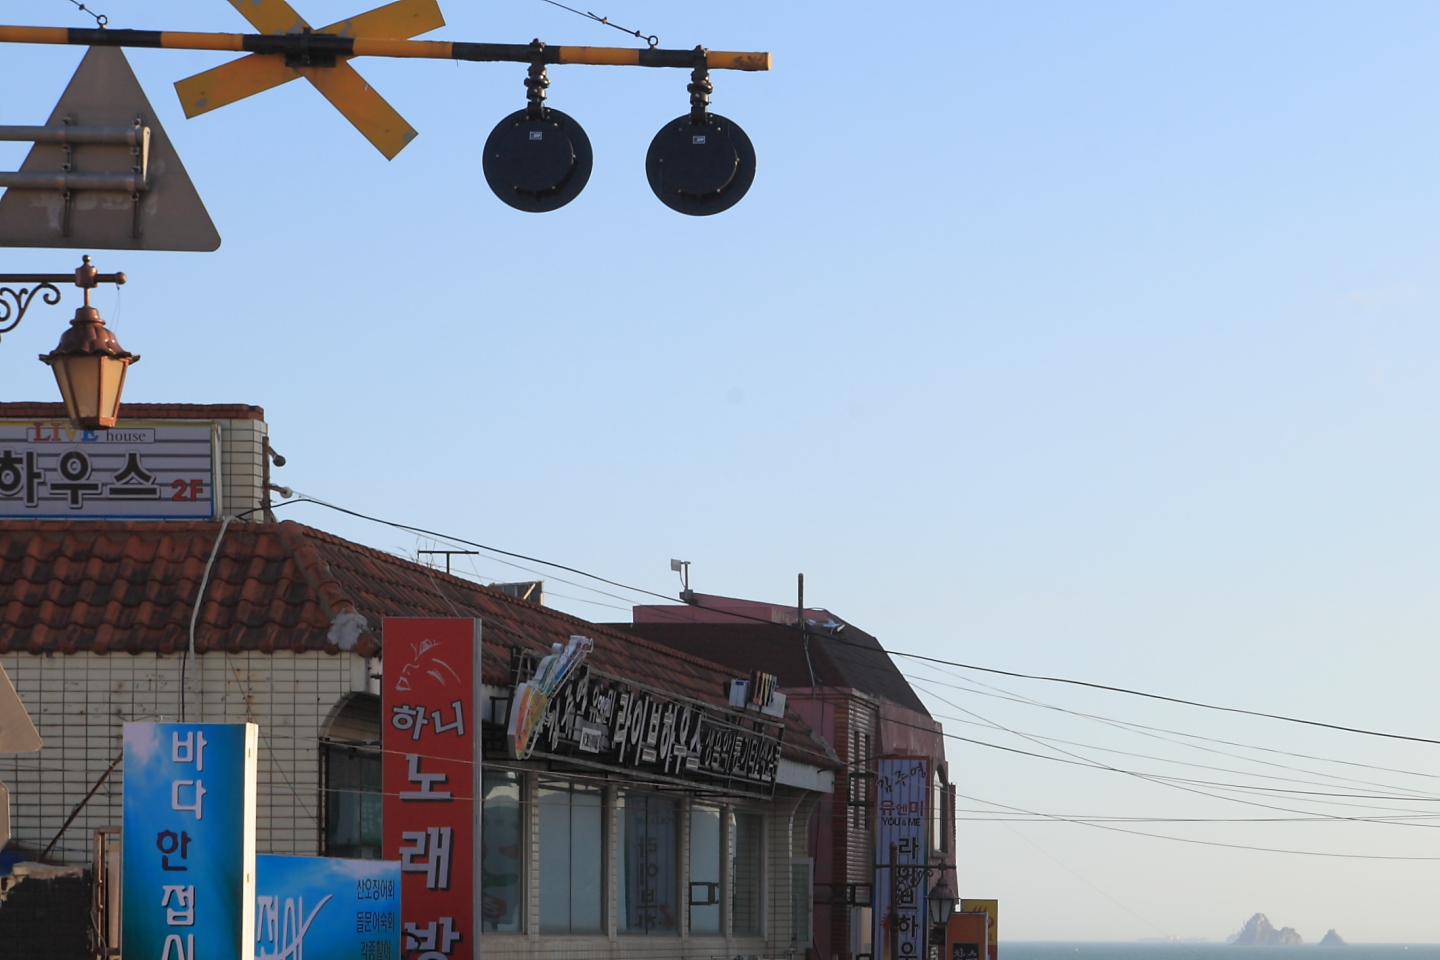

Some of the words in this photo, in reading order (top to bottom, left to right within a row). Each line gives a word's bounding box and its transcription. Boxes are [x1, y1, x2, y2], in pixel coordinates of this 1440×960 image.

[106, 429, 146, 442] house
[172, 480, 203, 501] 2F
[392, 700, 465, 740] 하니
[882, 818, 901, 826] YOU
[908, 818, 921, 827] ME
[356, 879, 396, 901] 산오징어회
